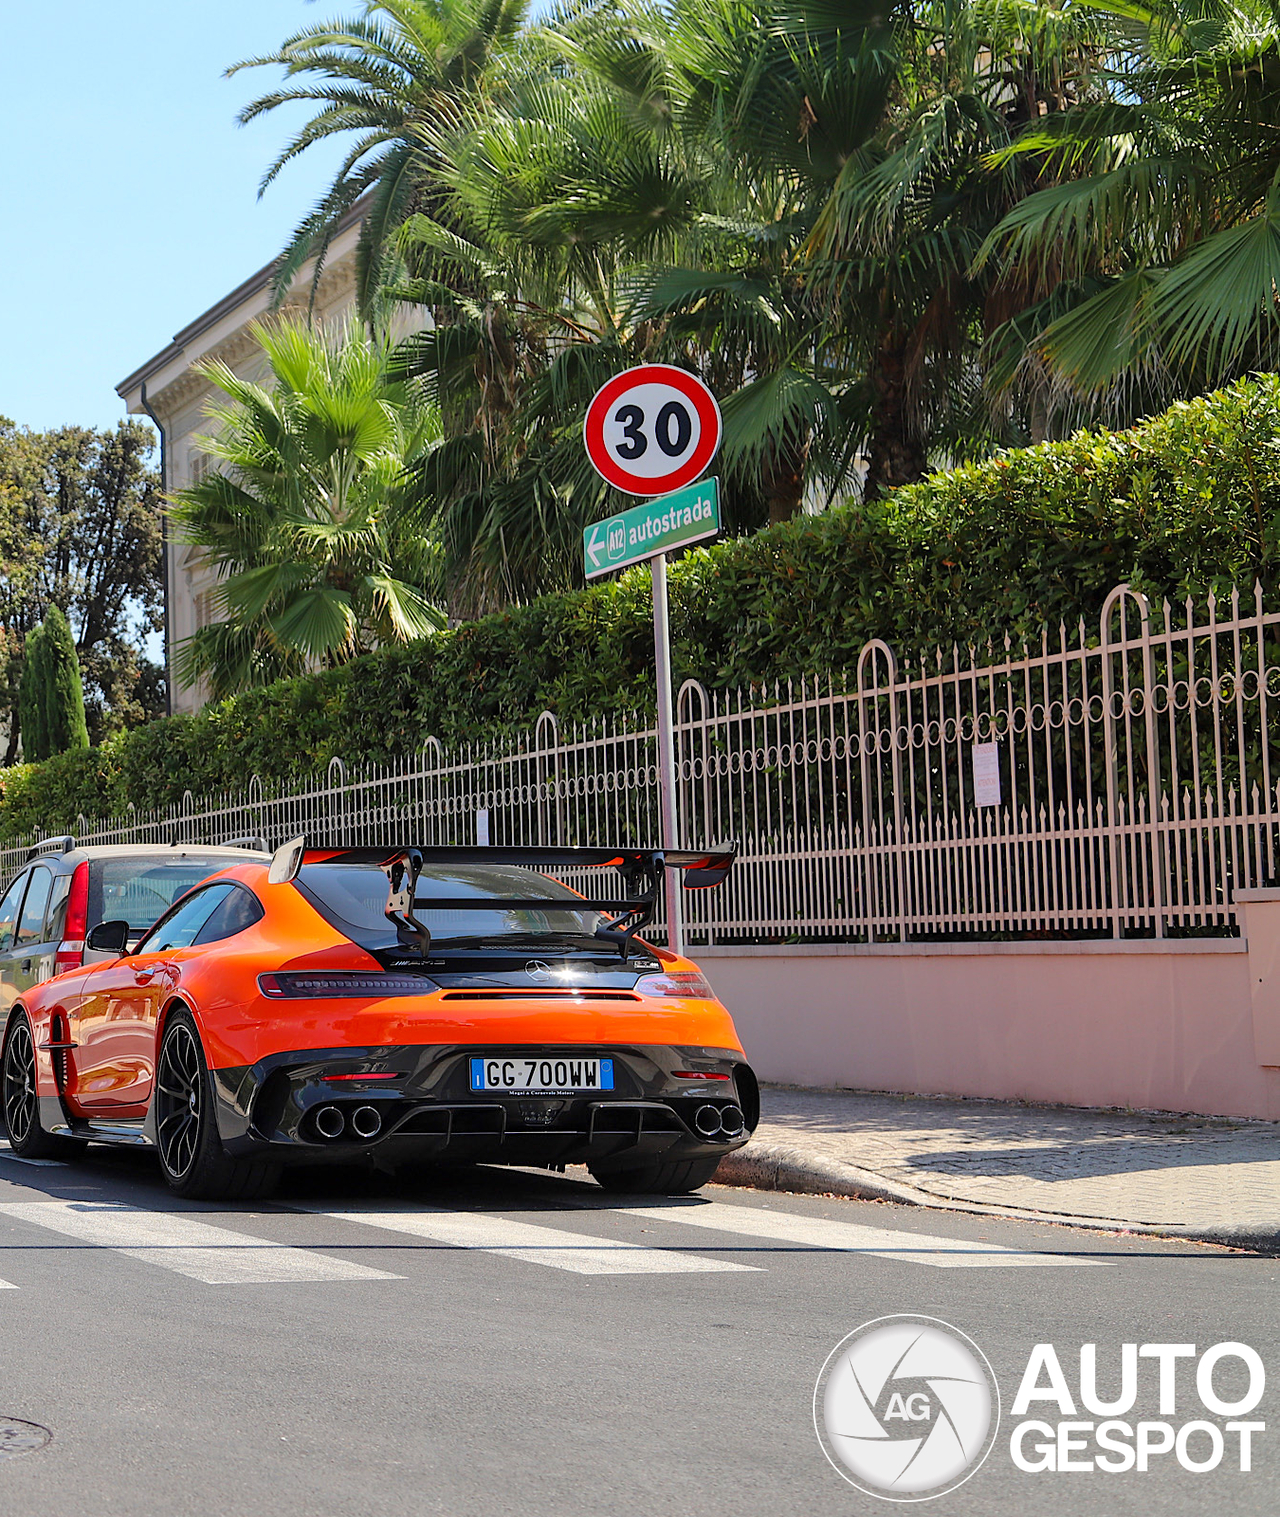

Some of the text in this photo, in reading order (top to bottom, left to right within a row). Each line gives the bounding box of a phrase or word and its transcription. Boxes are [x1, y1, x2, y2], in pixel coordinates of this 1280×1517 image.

[615, 401, 692, 460] 30
[609, 496, 712, 552] A12 autostrada
[487, 1061, 597, 1087] GG 700WW
